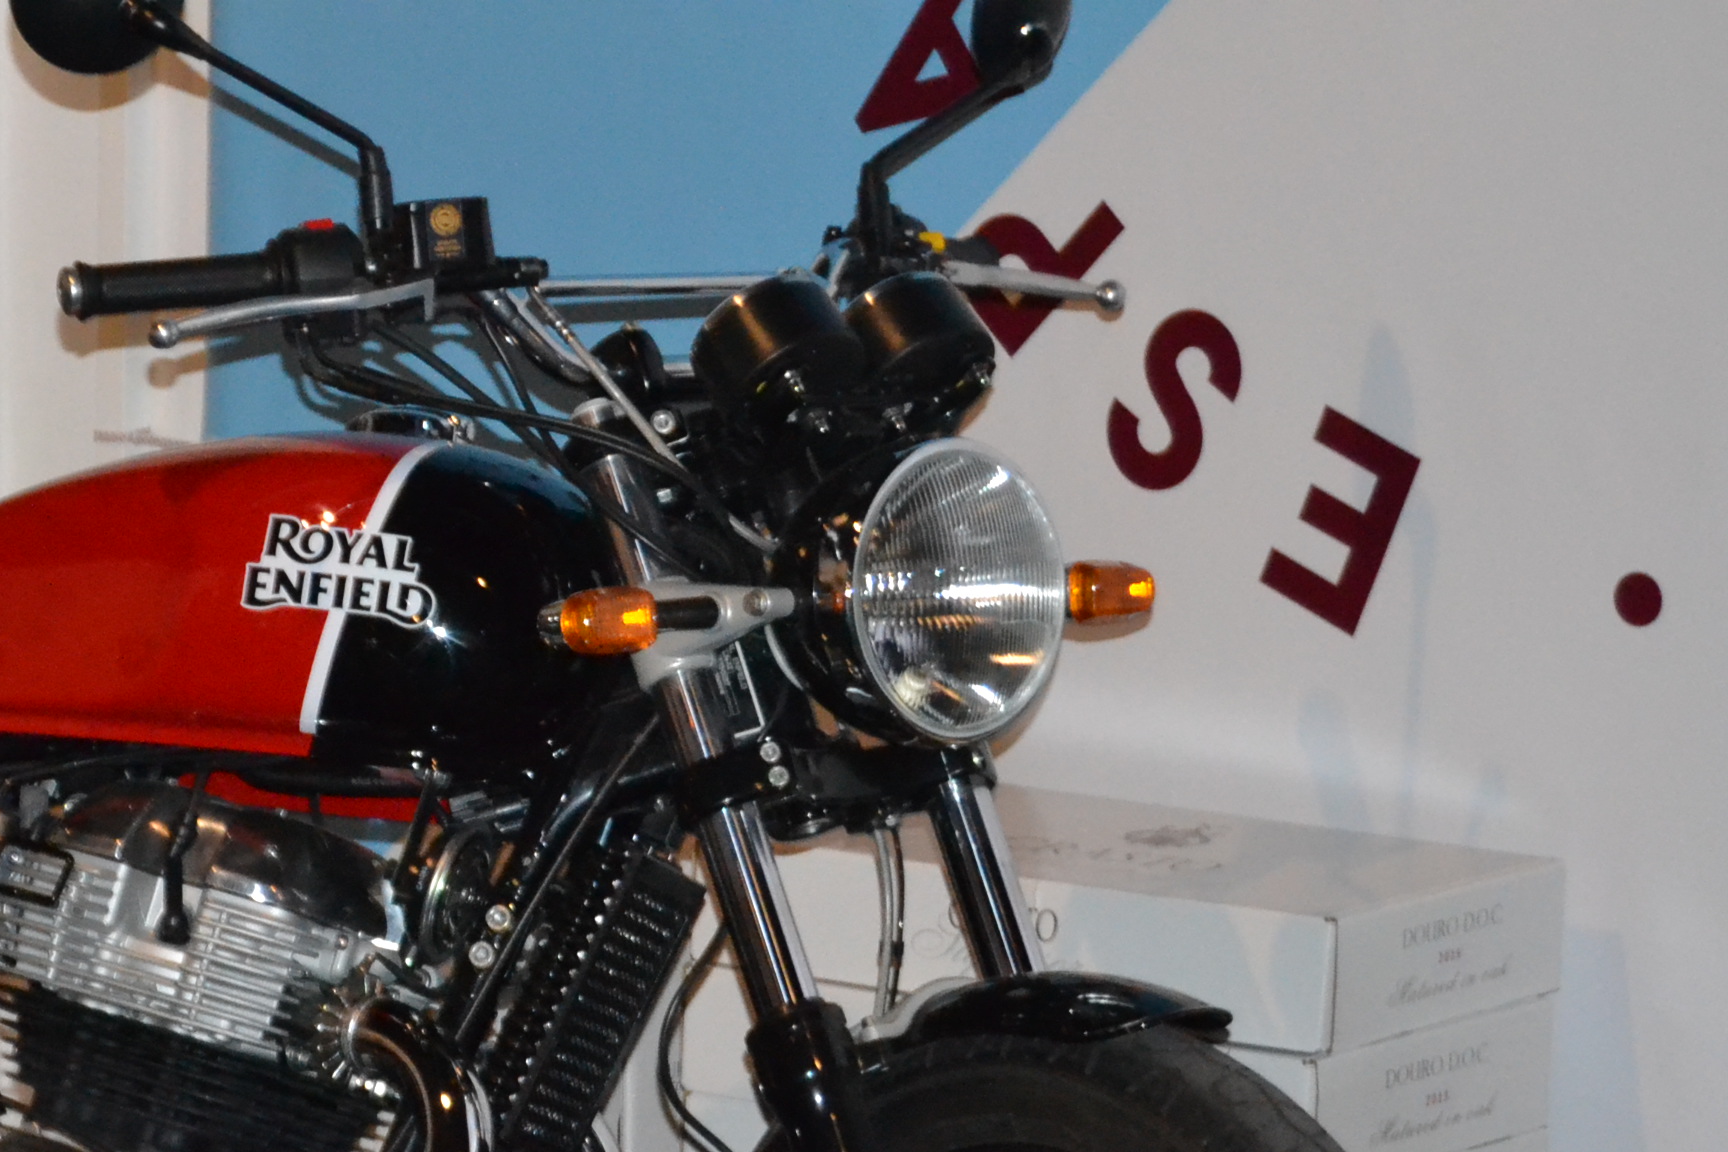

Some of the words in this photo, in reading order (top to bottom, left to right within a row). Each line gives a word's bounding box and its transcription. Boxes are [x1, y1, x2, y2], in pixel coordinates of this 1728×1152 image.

[263, 514, 420, 574] ROYAL
[241, 563, 434, 627] ENFIELD
[1402, 914, 1460, 949] DOURO
[1385, 1054, 1445, 1089] DOURO
